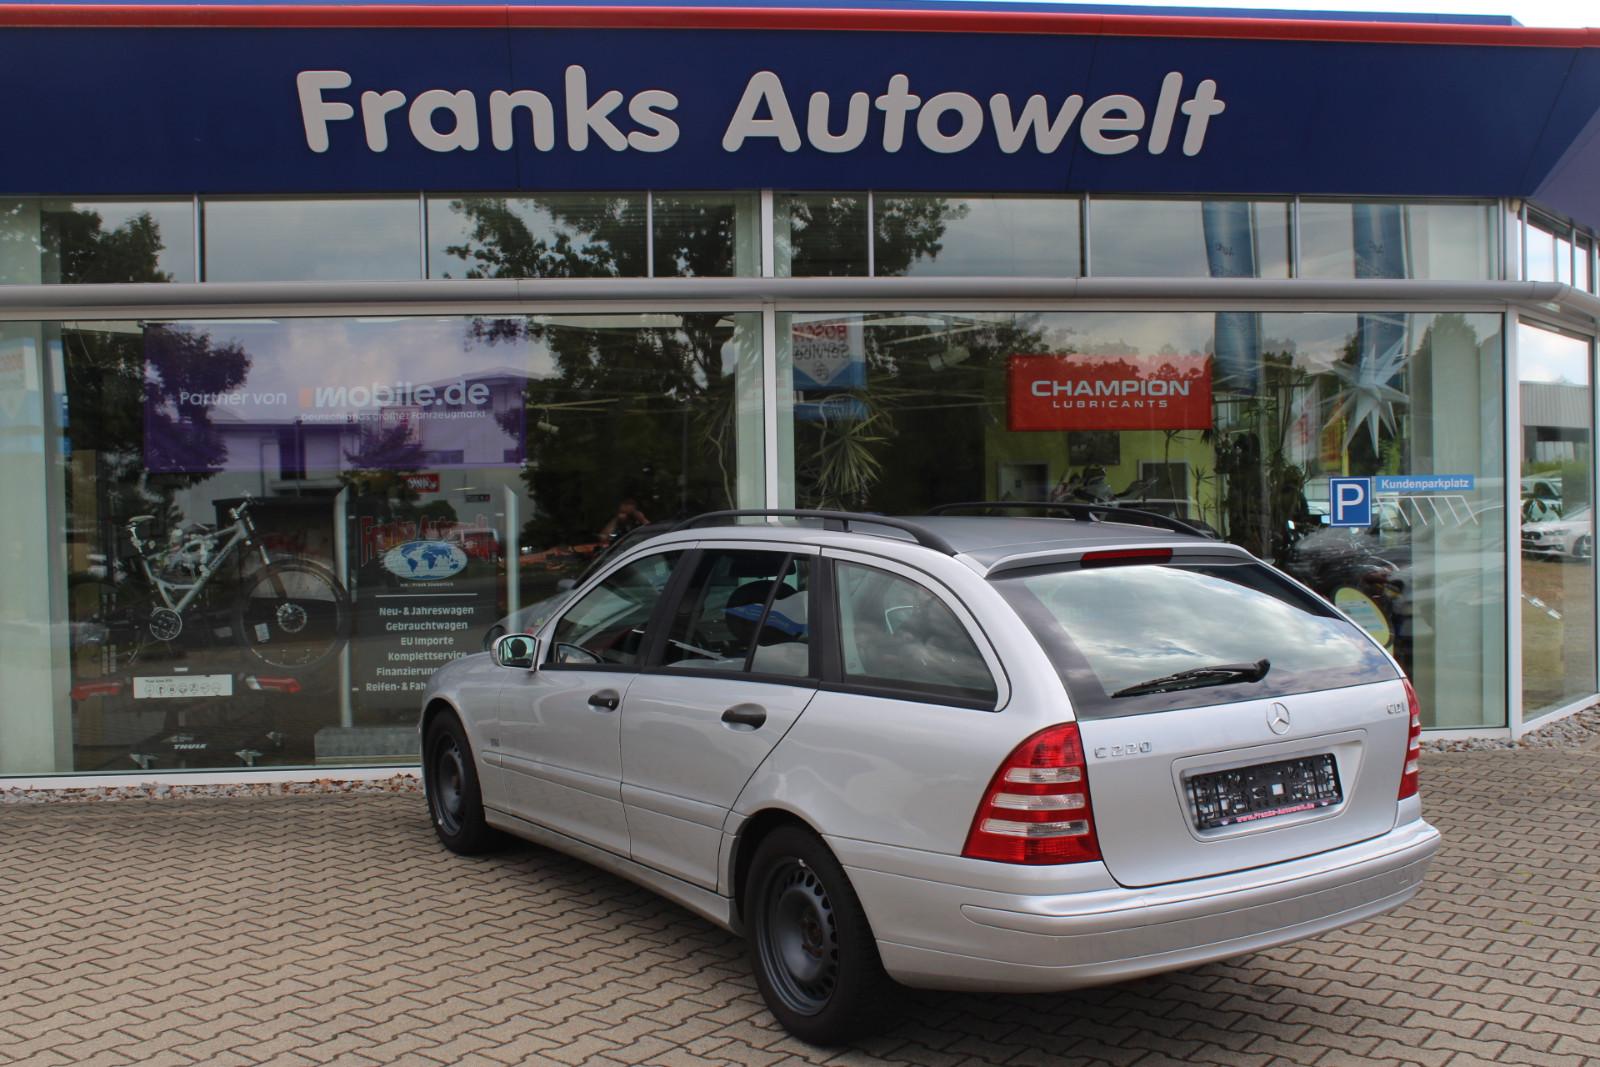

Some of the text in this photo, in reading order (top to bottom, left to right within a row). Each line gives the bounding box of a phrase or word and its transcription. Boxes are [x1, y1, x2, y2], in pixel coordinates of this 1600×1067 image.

[296, 65, 1226, 157] Franks Autowelt
[179, 380, 490, 408] Partner von mobile.de
[1031, 380, 1190, 397] CHAMPION
[1053, 400, 1168, 408] LUBRICANTS
[1381, 478, 1470, 490] Kundenparkplatz
[1337, 483, 1365, 521] P
[379, 606, 474, 616] Neu- & Jahreswagen
[386, 621, 468, 632] Gebrauchtwagen
[400, 636, 454, 648] EU Importe
[366, 682, 400, 692] Reifen-
[1095, 741, 1152, 759] C 220
